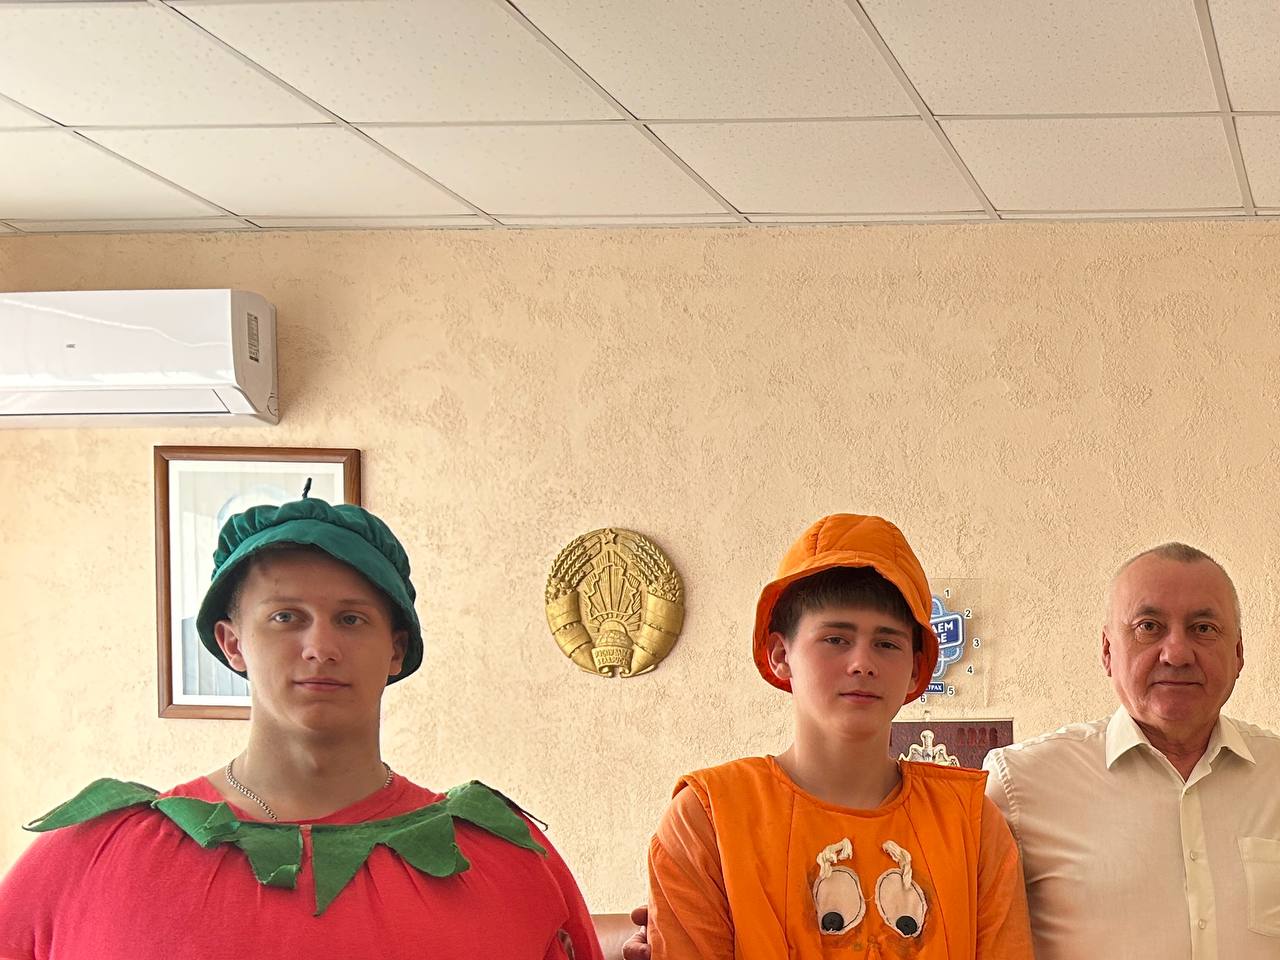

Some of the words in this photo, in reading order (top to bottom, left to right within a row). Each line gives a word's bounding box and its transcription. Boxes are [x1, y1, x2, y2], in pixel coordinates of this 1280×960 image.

[944, 588, 951, 598] 1
[964, 608, 972, 618] 2
[973, 638, 980, 648] 3
[966, 665, 974, 674] 4
[925, 684, 943, 692] ТРАХ
[947, 686, 955, 696] 5
[919, 694, 927, 703] 6
